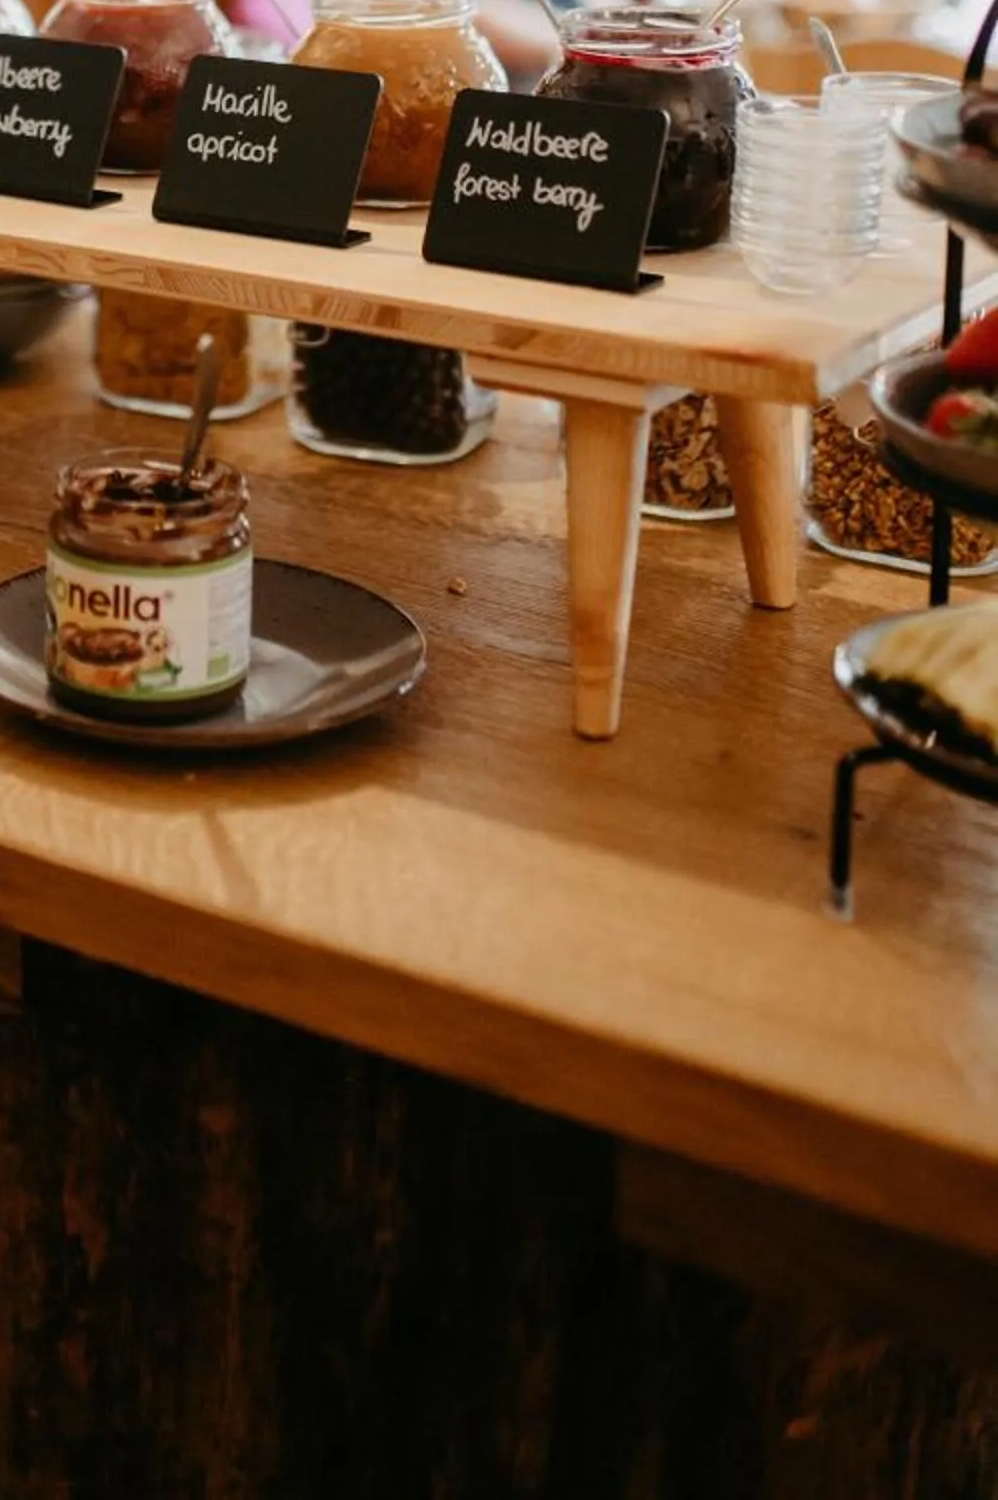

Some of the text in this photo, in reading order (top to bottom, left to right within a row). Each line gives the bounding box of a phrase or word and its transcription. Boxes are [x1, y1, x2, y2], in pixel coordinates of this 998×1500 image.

[201, 82, 293, 125] Marille
[186, 129, 280, 166] apricot
[465, 116, 609, 162] Waldbeere
[453, 162, 605, 233] forest berry
